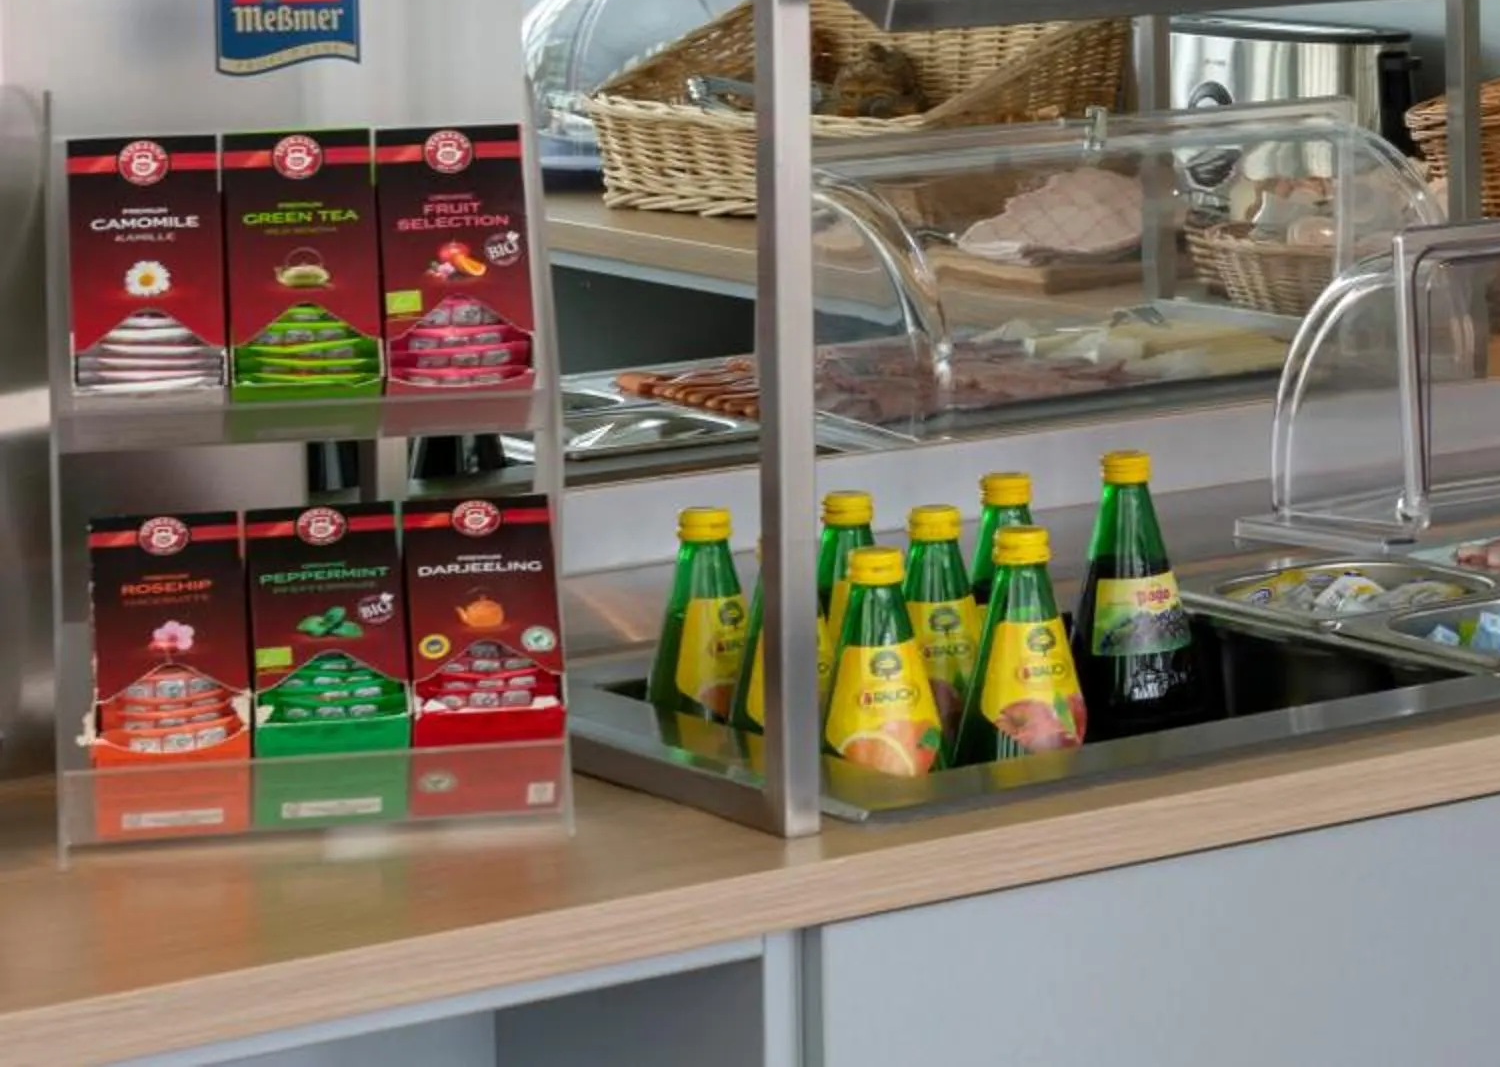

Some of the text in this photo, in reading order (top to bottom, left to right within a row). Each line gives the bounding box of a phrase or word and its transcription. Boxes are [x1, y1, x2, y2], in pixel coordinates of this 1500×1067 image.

[231, 5, 344, 33] Meßmer
[423, 201, 482, 215] FRUIT
[90, 215, 200, 231] CAMOMILE
[243, 209, 359, 225] GREEN TEA
[396, 214, 510, 231] SELECTION
[487, 240, 519, 261] BIO
[259, 566, 391, 586] PEPPERMINT
[417, 560, 544, 577] DARJEELING
[120, 579, 213, 595] ROSEHIP
[359, 600, 394, 619] BIO
